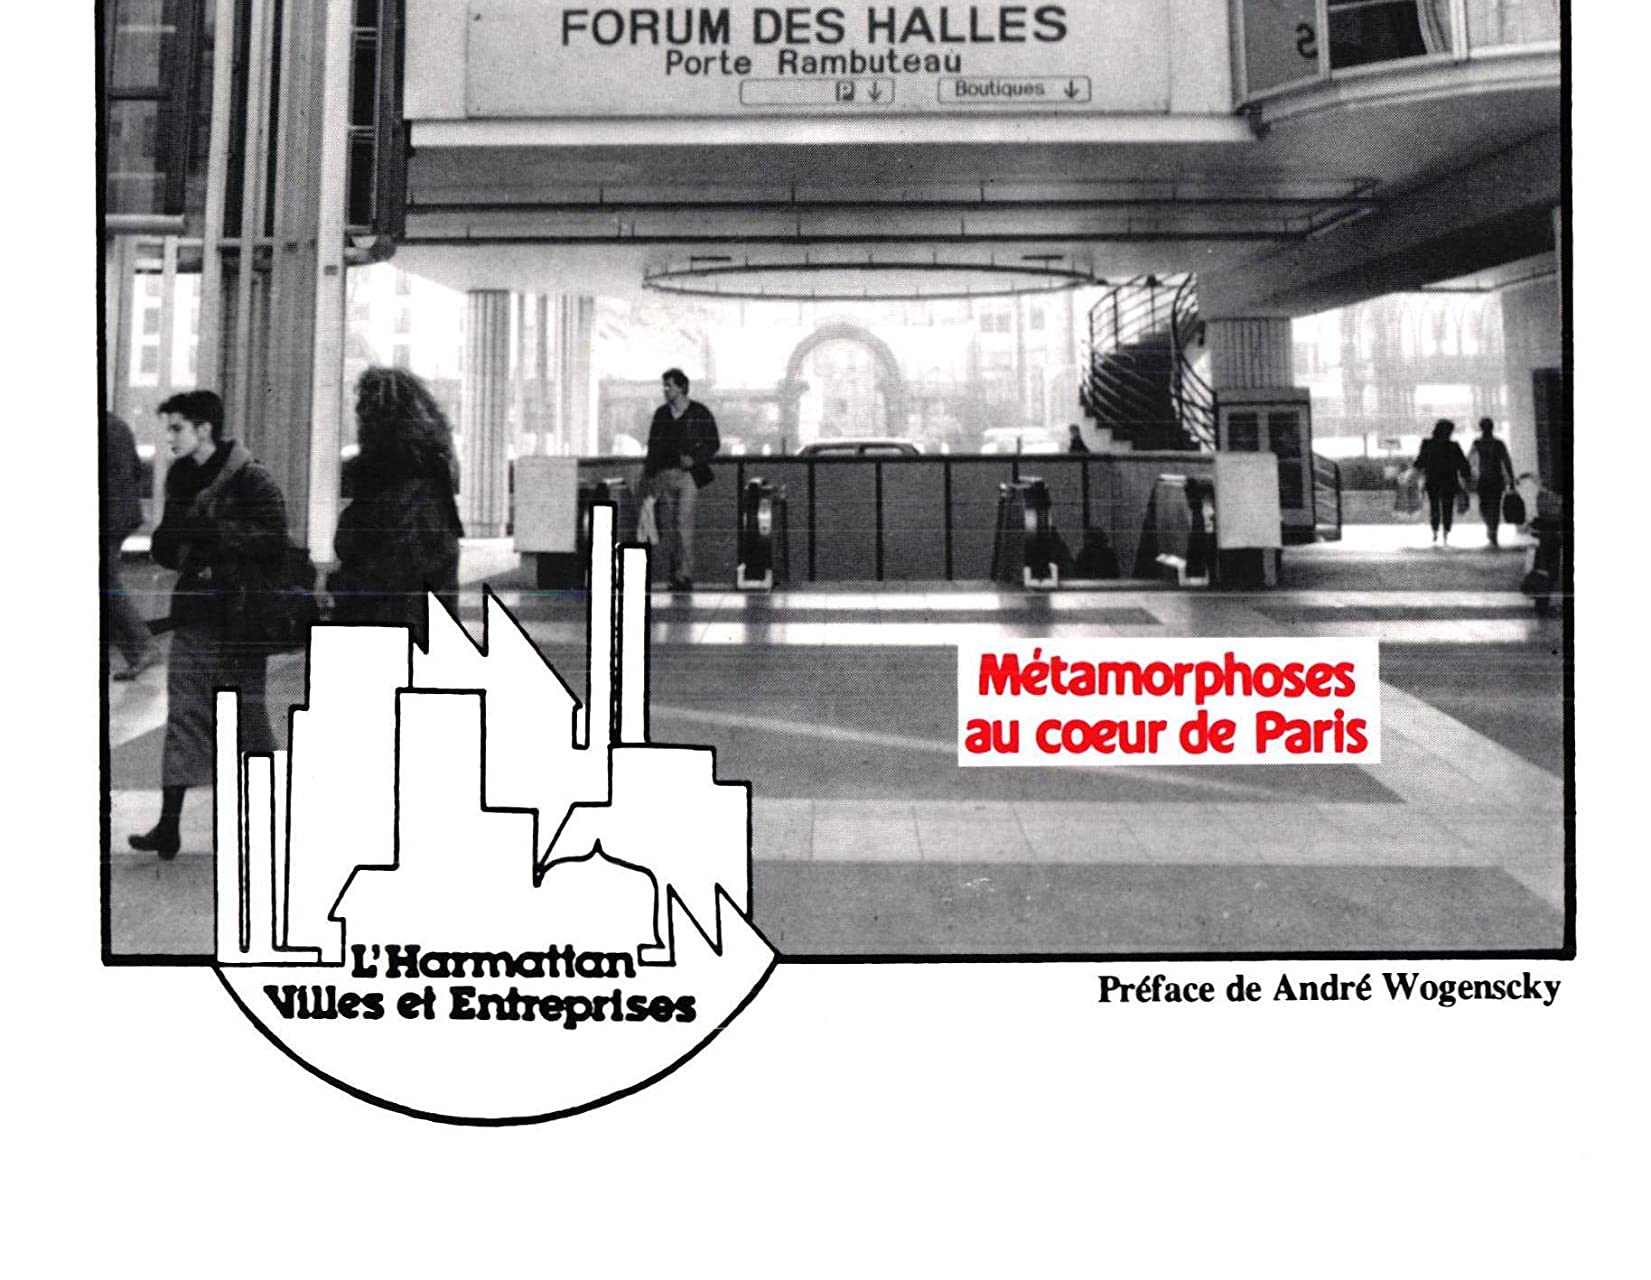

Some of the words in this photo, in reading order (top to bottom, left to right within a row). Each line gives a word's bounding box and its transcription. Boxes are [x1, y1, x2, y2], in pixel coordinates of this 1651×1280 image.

[563, 9, 729, 45] FORUM
[754, 8, 844, 44] DES
[869, 6, 1066, 43] HALLES
[667, 50, 751, 74] Porte
[779, 49, 961, 74] Rambuteau
[956, 80, 1046, 99] Boutiques
